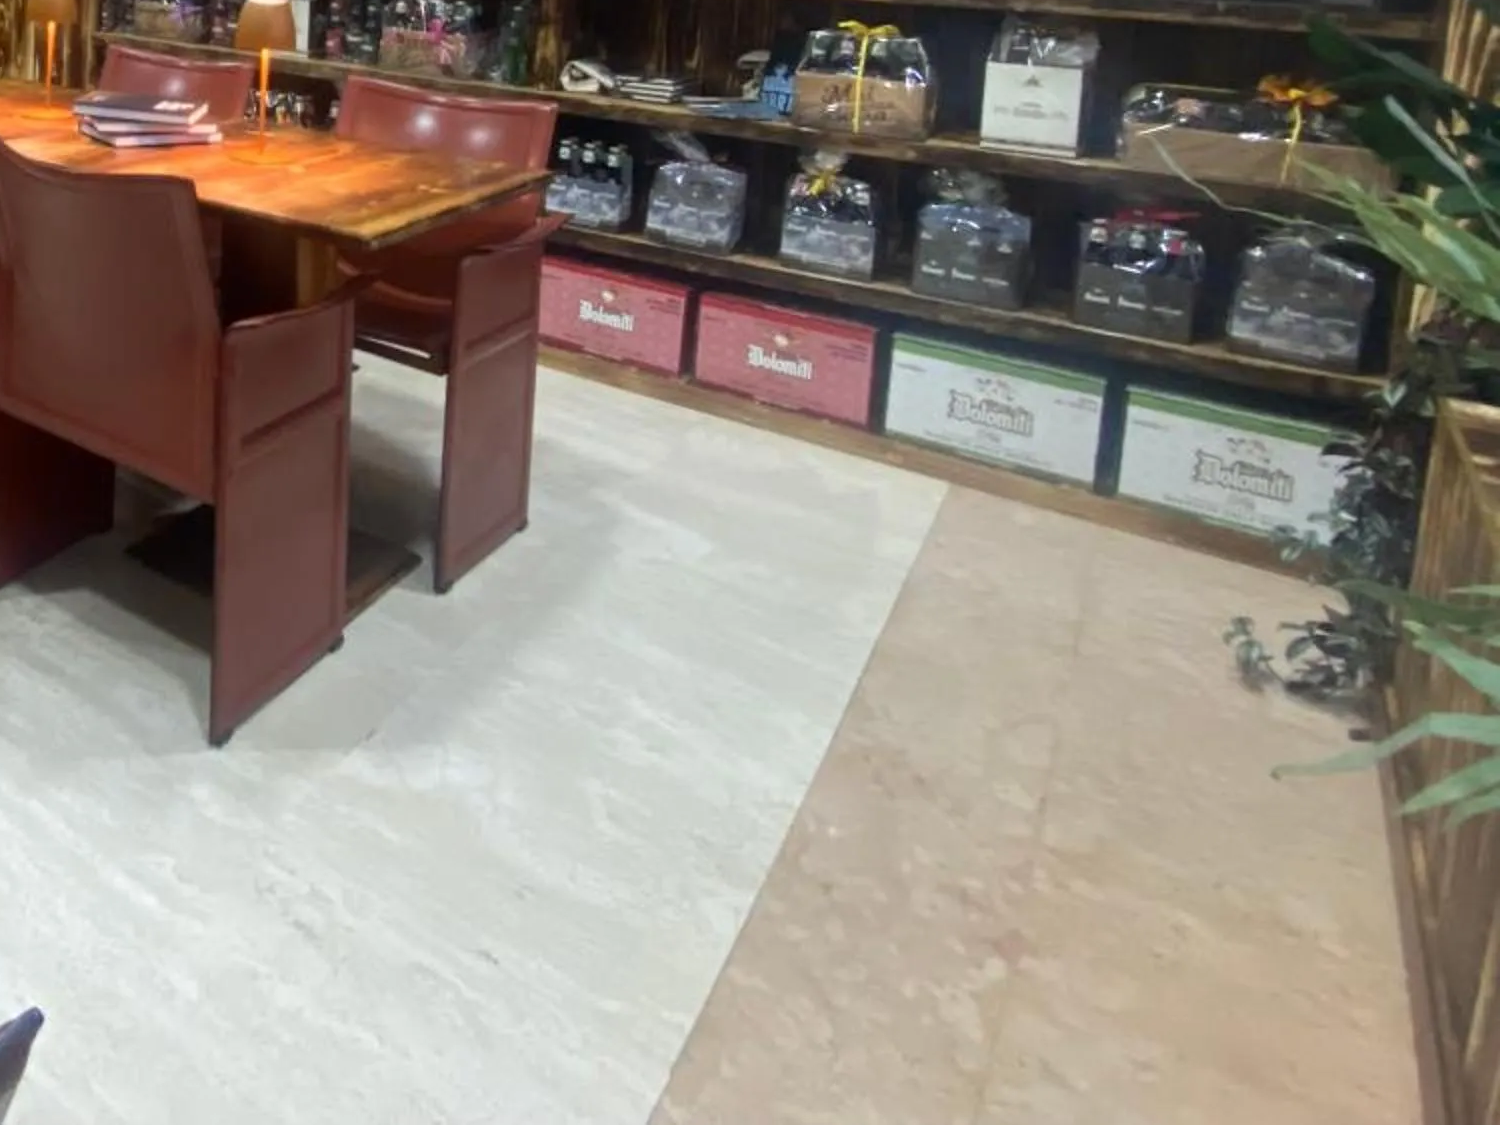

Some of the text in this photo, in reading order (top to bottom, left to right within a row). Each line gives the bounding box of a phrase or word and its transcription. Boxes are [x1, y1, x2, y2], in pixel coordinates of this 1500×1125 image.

[579, 298, 634, 332] Dolomiti
[748, 344, 812, 380] Dolomiti
[947, 389, 1035, 438] Dolomiti
[1193, 449, 1295, 502] Dolomiti
